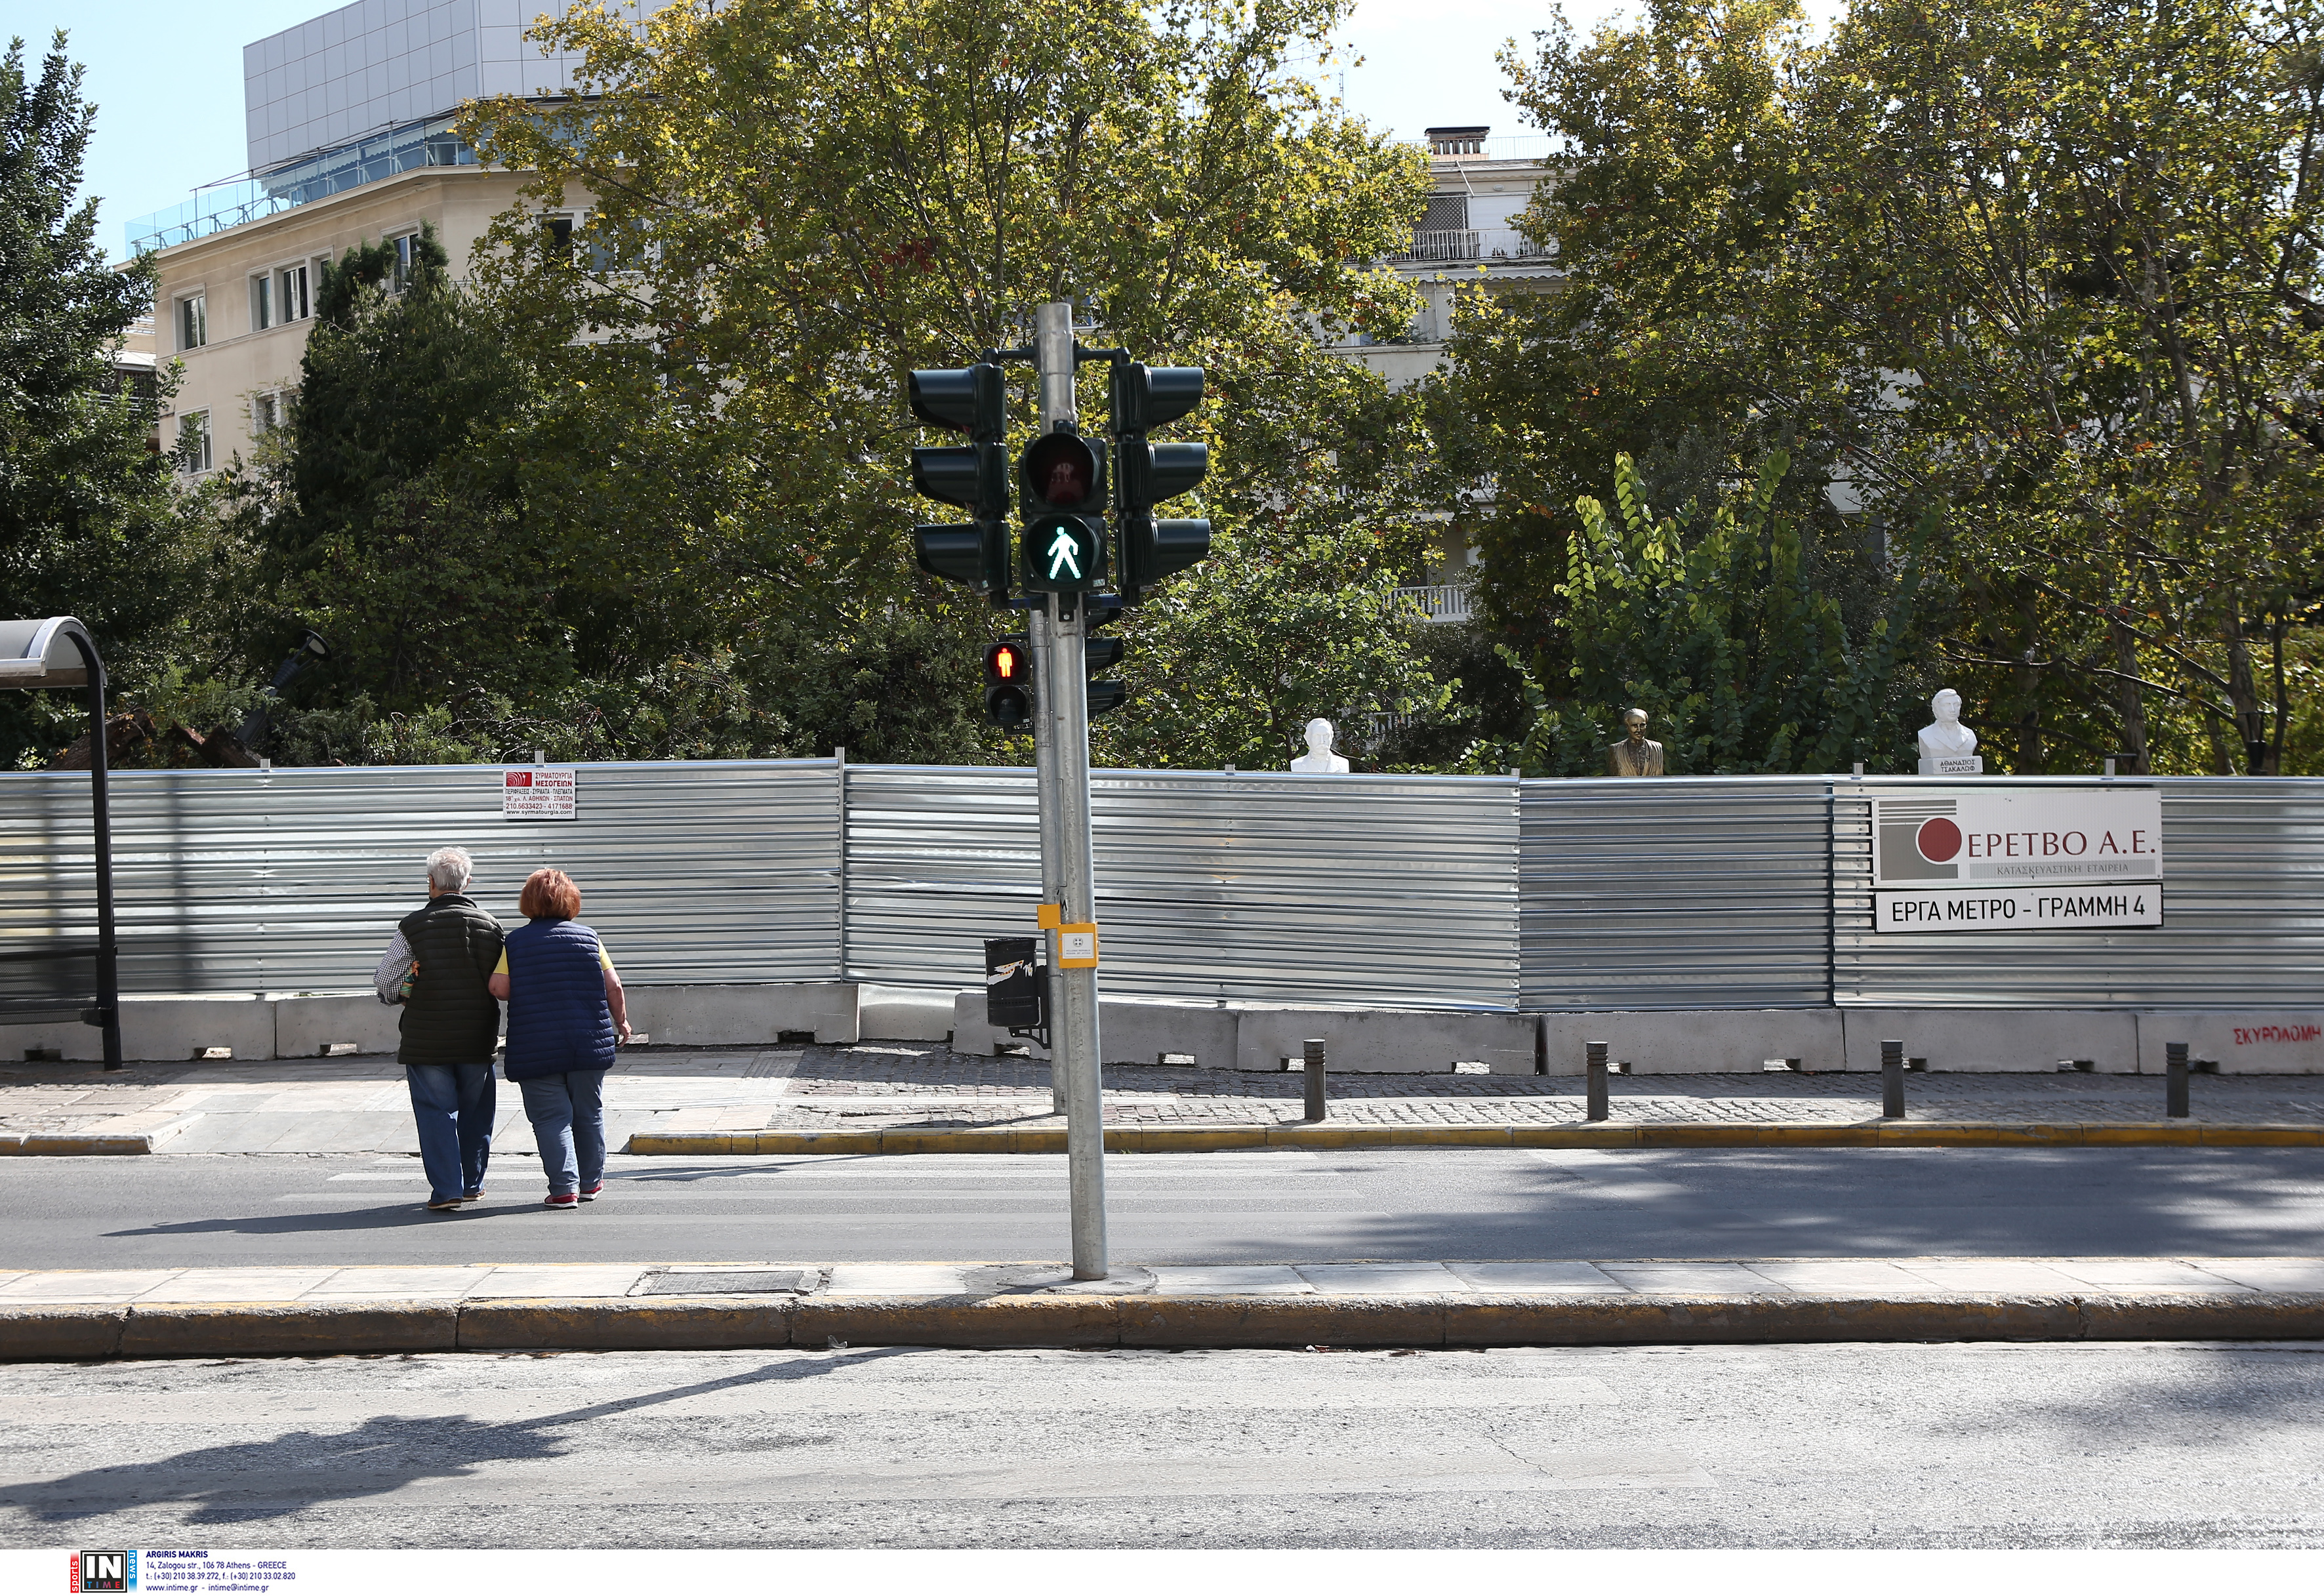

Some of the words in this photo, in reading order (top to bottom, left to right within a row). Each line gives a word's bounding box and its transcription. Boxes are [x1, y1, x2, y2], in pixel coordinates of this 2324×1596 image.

[2098, 830, 2155, 855] Α.Ε.
[1997, 865, 2082, 876] ΚΑΤΑΣΚΕΥΑΣΤΙΚΗ
[2087, 863, 2129, 873] ΕΤΑΙΡΕΙΑ
[1892, 901, 1942, 921] ΕΡΓΑ
[1947, 899, 2016, 920] ΜΕΤΡΟ
[2038, 896, 2127, 918] ΓΡΑΜΜΗ
[2133, 895, 2146, 915] 4
